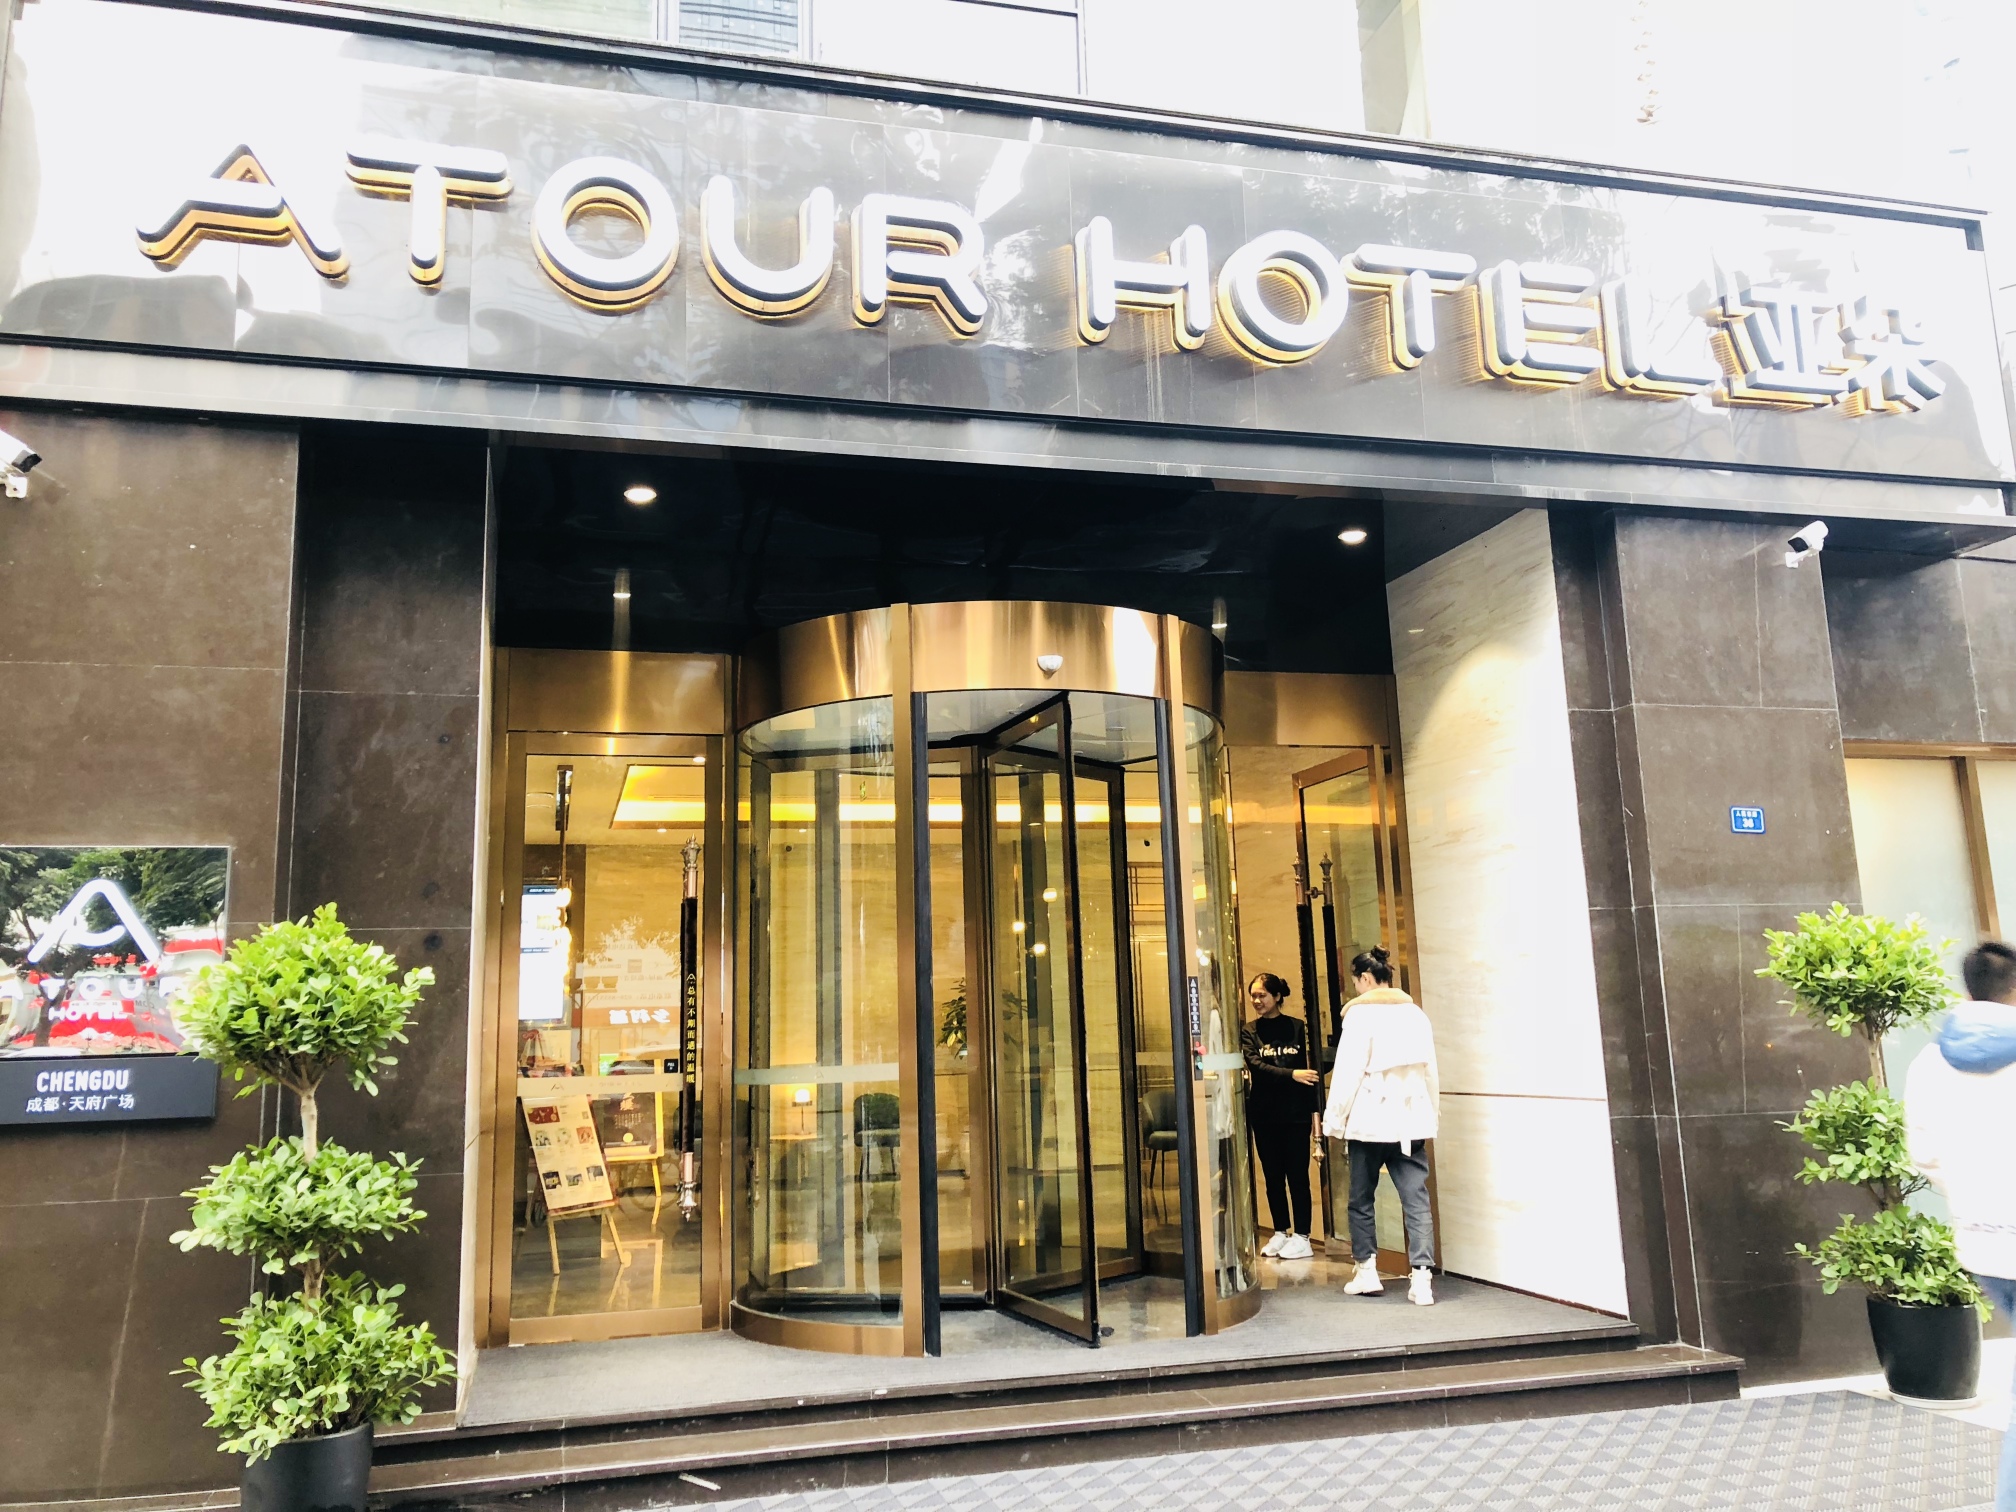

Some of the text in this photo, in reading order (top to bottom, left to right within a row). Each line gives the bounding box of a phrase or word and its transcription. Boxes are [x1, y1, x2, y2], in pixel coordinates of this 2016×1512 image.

[135, 137, 1722, 398] ATOUR HOTEL
[48, 1005, 128, 1021] HOTEL
[36, 1069, 130, 1093] CHENGDU
[26, 1094, 135, 1113] 成都·天府广场
